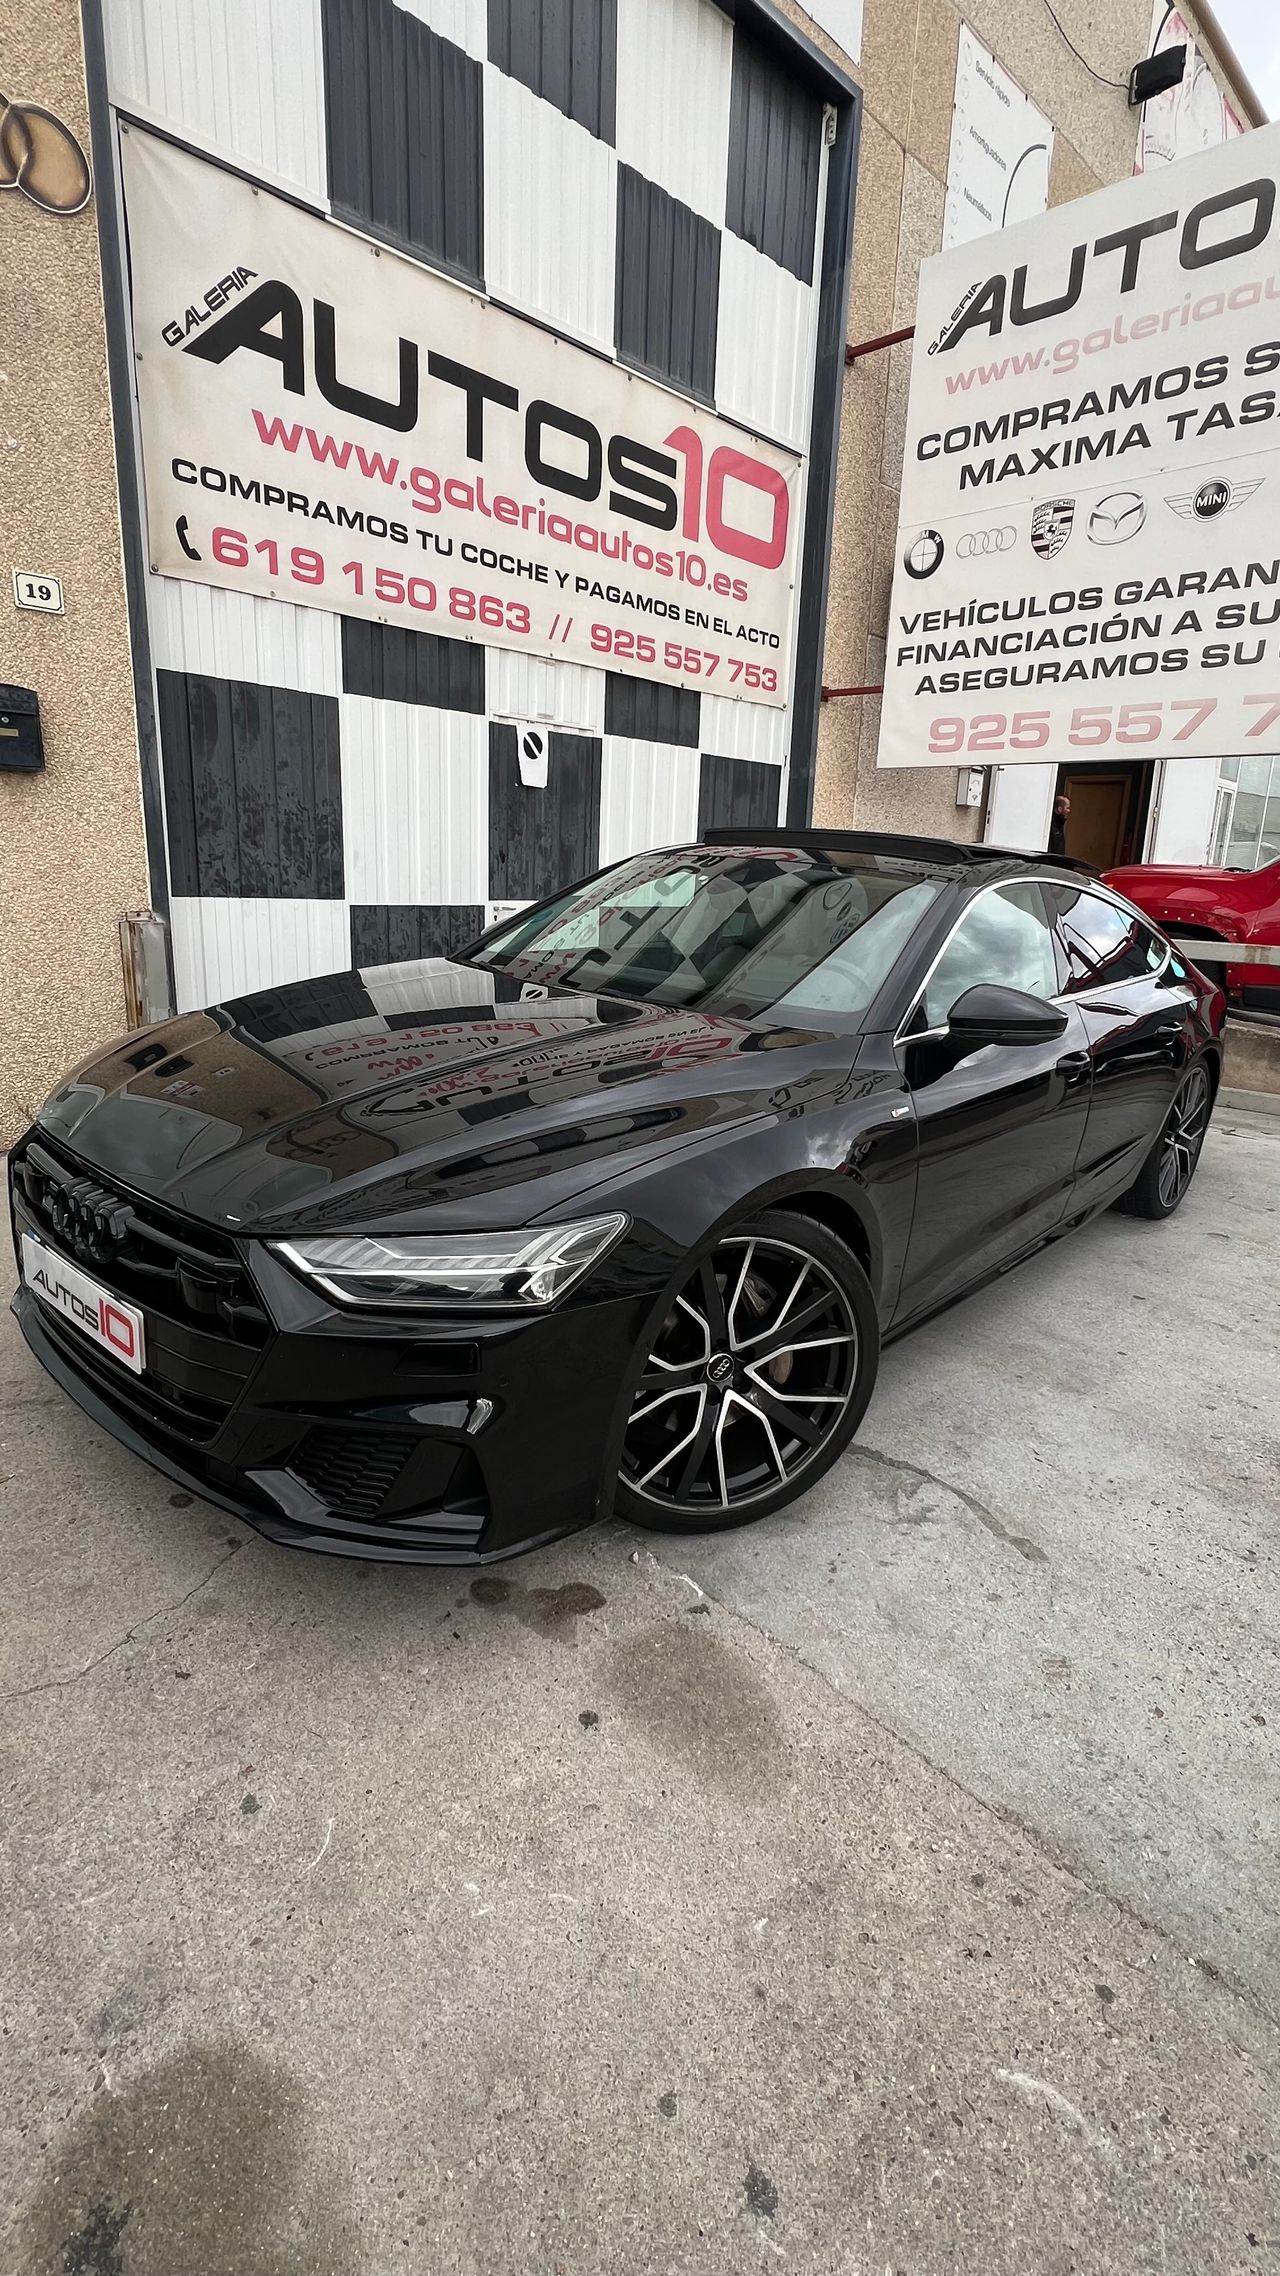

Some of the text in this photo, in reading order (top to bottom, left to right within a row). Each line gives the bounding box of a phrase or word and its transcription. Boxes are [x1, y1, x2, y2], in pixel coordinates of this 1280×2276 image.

[161, 265, 259, 347] GALERIA
[927, 281, 983, 356] GALERIA
[916, 354, 1230, 461] COMPRAMOS
[959, 390, 1280, 491] MAXIMA TAS
[251, 408, 748, 602] www.galeriaautos10.es
[1197, 491, 1227, 509] MINI
[172, 457, 780, 649] COMPRAMOS TU COCHE Y PAGAMOS EN EL ACTO
[26, 583, 51, 601] 19
[211, 526, 325, 586] 619
[342, 561, 437, 612] 150
[449, 587, 532, 634] 863
[590, 623, 656, 664] 925
[664, 641, 720, 678] 557
[727, 658, 778, 693] 753
[900, 587, 1103, 636] VEHÍCULOS
[897, 598, 1280, 667] FINANCIACIÓN A SU
[915, 648, 1188, 697] ASEGURAMOS
[1200, 639, 1267, 669] SU
[928, 711, 1051, 754] 925
[1067, 697, 1218, 746] 557
